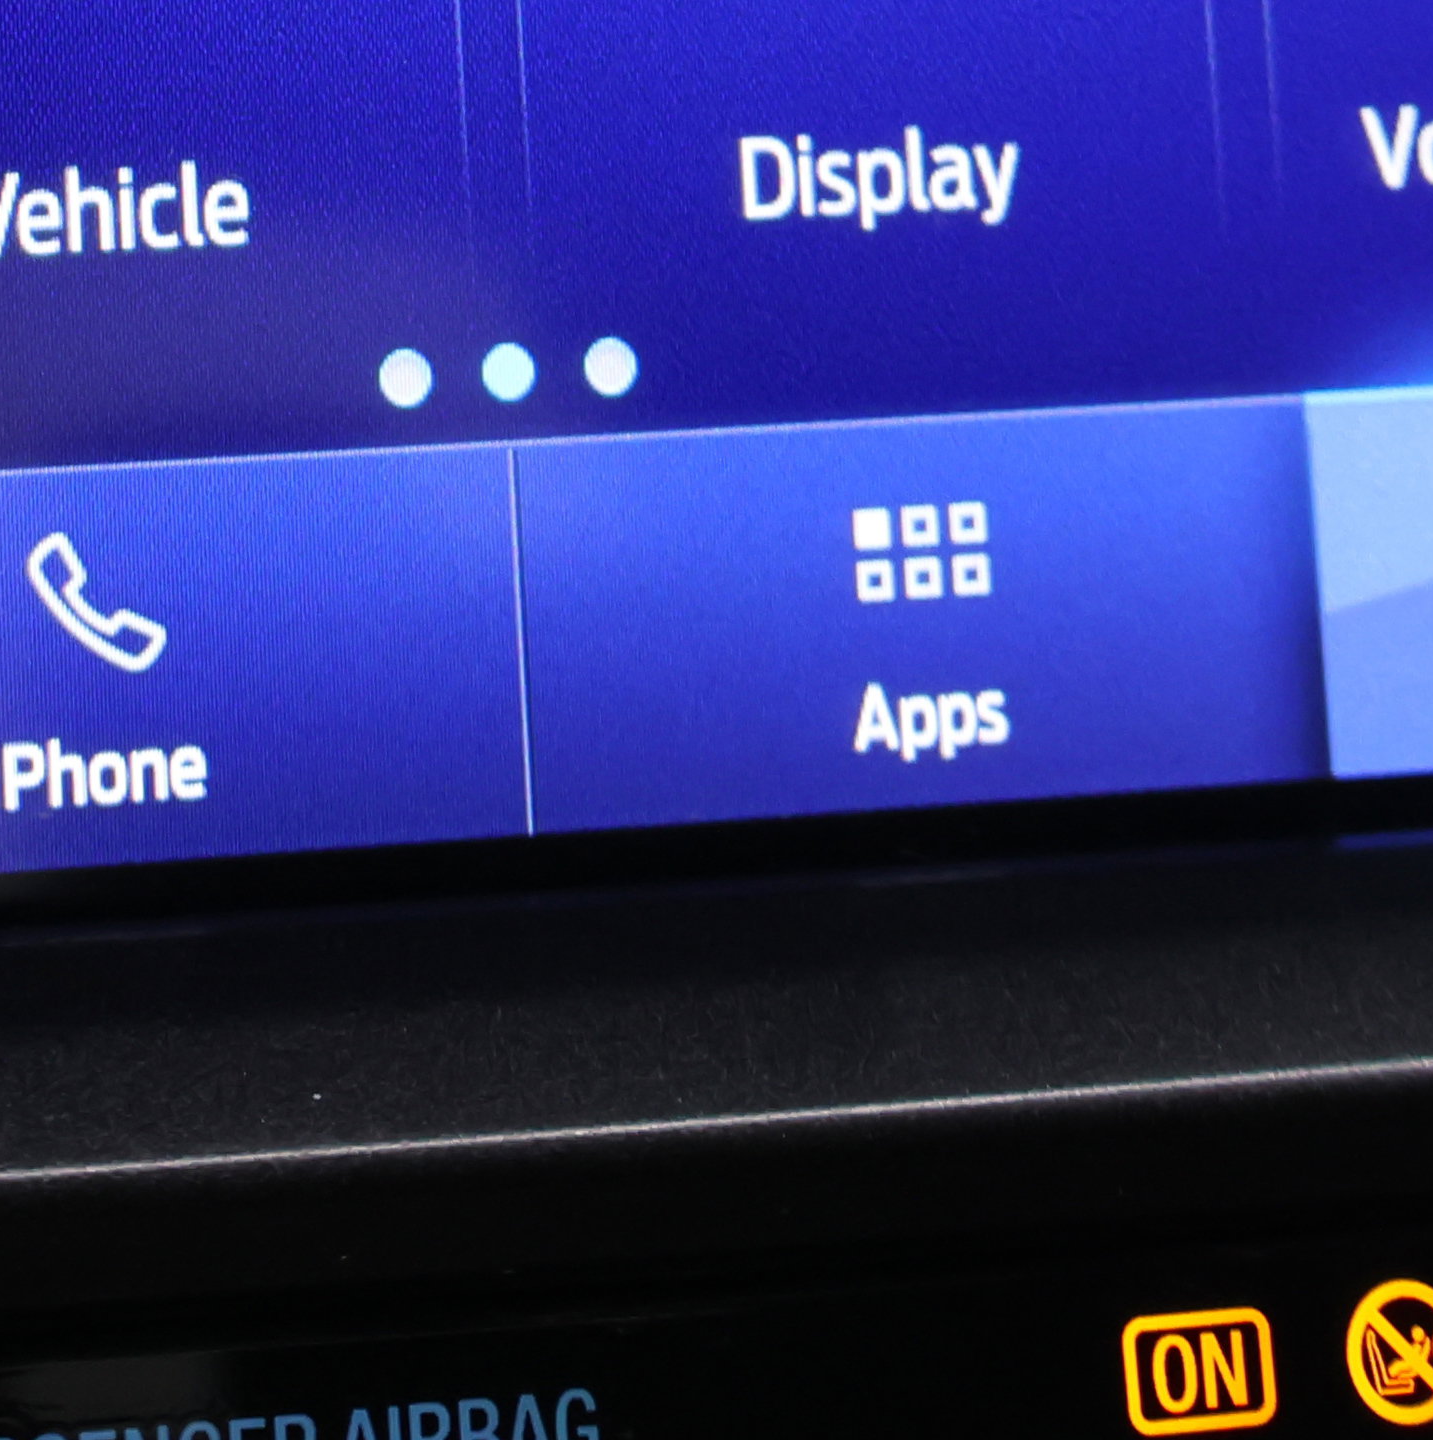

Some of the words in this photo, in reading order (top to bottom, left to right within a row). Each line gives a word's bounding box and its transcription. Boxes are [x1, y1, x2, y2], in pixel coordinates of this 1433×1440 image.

[738, 125, 1019, 231] Display
[853, 683, 1010, 763] Apps
[0, 737, 208, 812] Phone
[1151, 1328, 1249, 1414] ON
